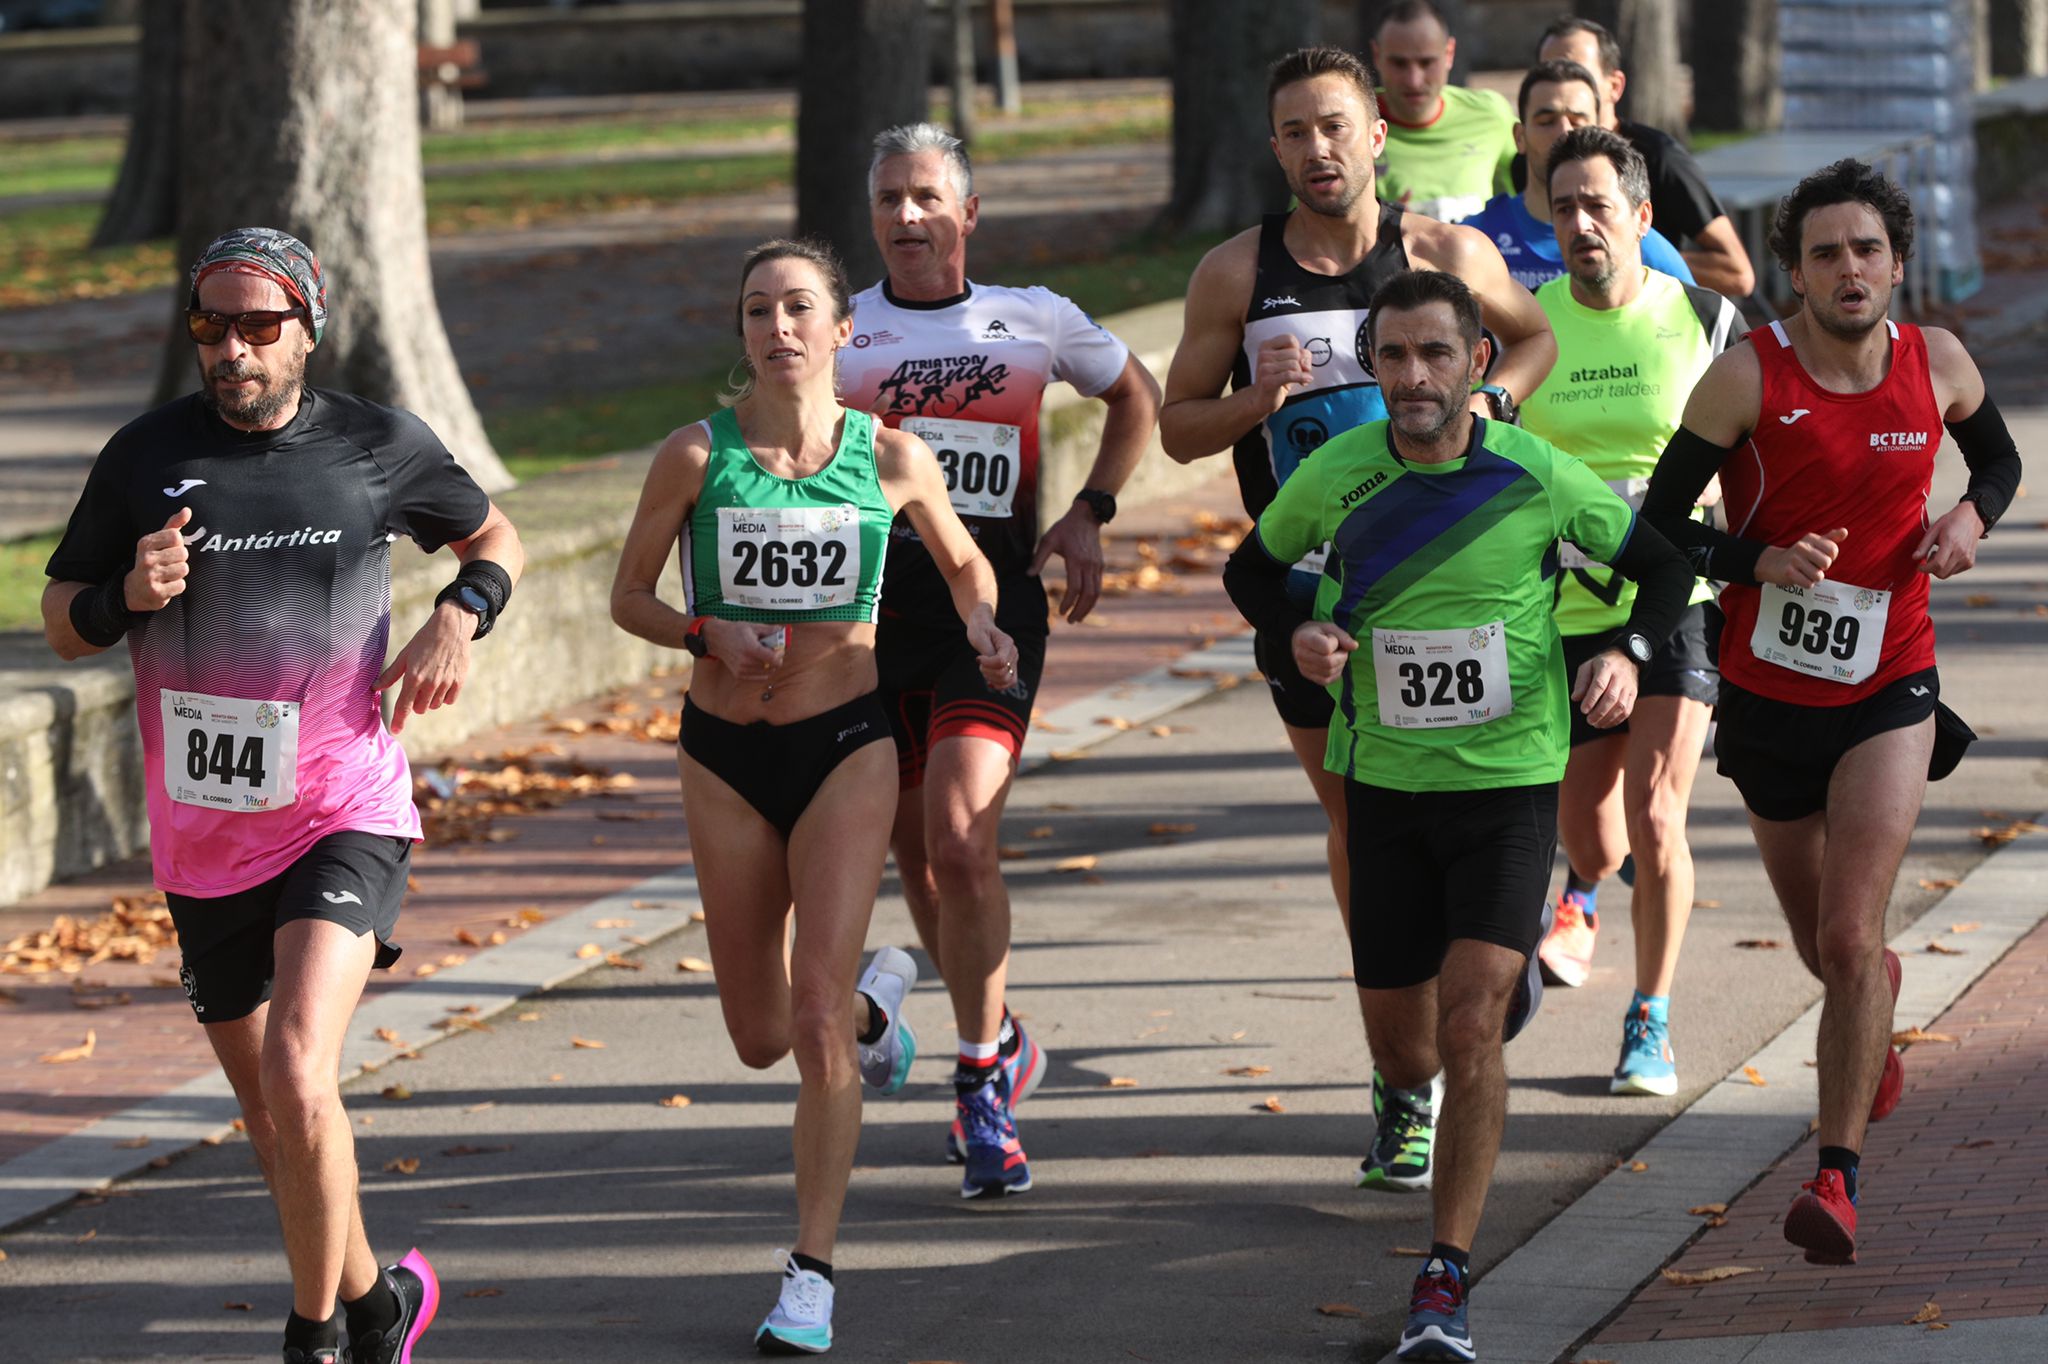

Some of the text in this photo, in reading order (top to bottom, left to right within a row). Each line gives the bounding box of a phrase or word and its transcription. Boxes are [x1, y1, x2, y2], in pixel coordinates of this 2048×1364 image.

[911, 354, 982, 370] TRIATLON
[876, 355, 1010, 389] Aranda
[1570, 363, 1638, 383] atzabal
[1550, 382, 1661, 404] mendi taldea
[732, 512, 746, 523] LA
[732, 523, 767, 534] MEDIA
[200, 526, 342, 552] Antártica
[732, 540, 847, 587] 2632
[1779, 602, 1860, 660] 939
[1383, 634, 1396, 644] LA
[1385, 645, 1416, 655] MEDIA
[1833, 665, 1855, 678] Vital
[1399, 659, 1484, 708] 328
[172, 696, 186, 706] LA
[174, 706, 202, 720] MEDIA
[1468, 707, 1490, 719] Vital
[187, 728, 266, 788] 844
[210, 796, 232, 804] CORREO
[243, 794, 269, 806] Vital
